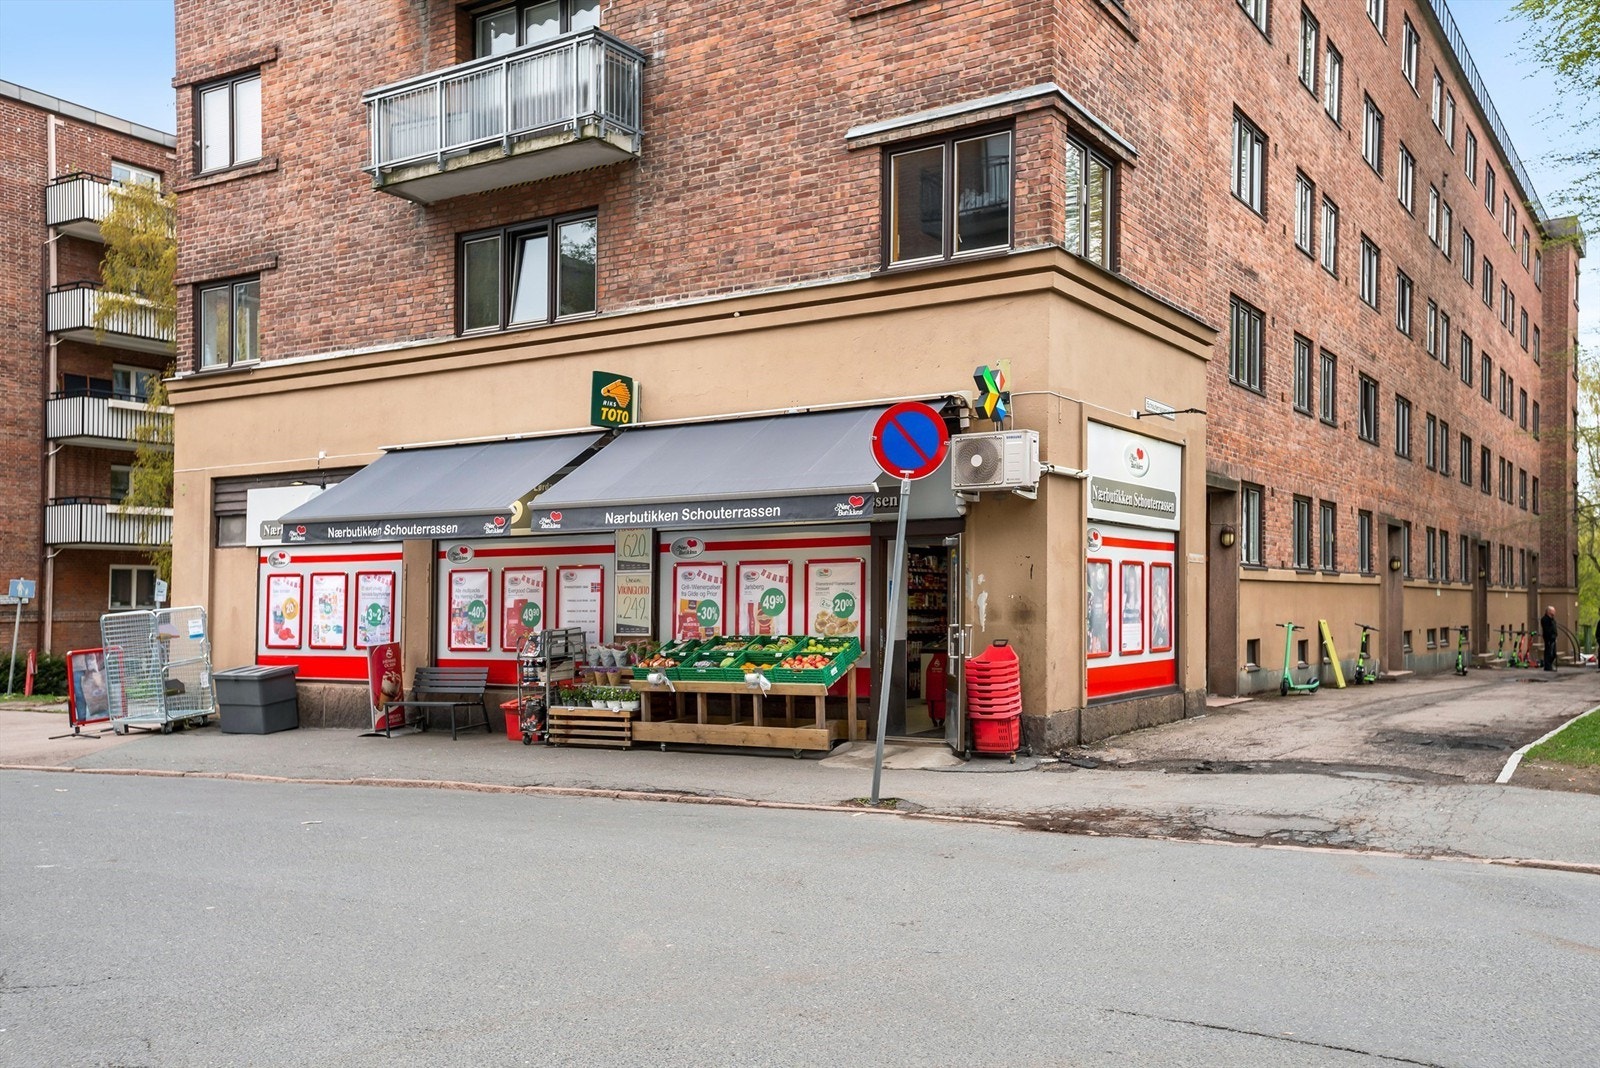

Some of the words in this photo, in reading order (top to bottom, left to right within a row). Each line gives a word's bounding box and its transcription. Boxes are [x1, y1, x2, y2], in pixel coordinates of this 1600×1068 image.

[601, 407, 629, 423] TOTO
[1092, 484, 1133, 506] Nærbutikken
[1133, 492, 1175, 513] Schouterrassen
[605, 510, 678, 525] Nærbutikken
[681, 506, 781, 521] Schouterrassen
[327, 526, 382, 538] Nærbutikken
[383, 523, 458, 536] Schouterrassen
[623, 533, 646, 557] 620
[368, 609, 372, 620] 3
[377, 609, 382, 620] 2
[623, 596, 646, 619] 249
[697, 606, 718, 620] -30%
